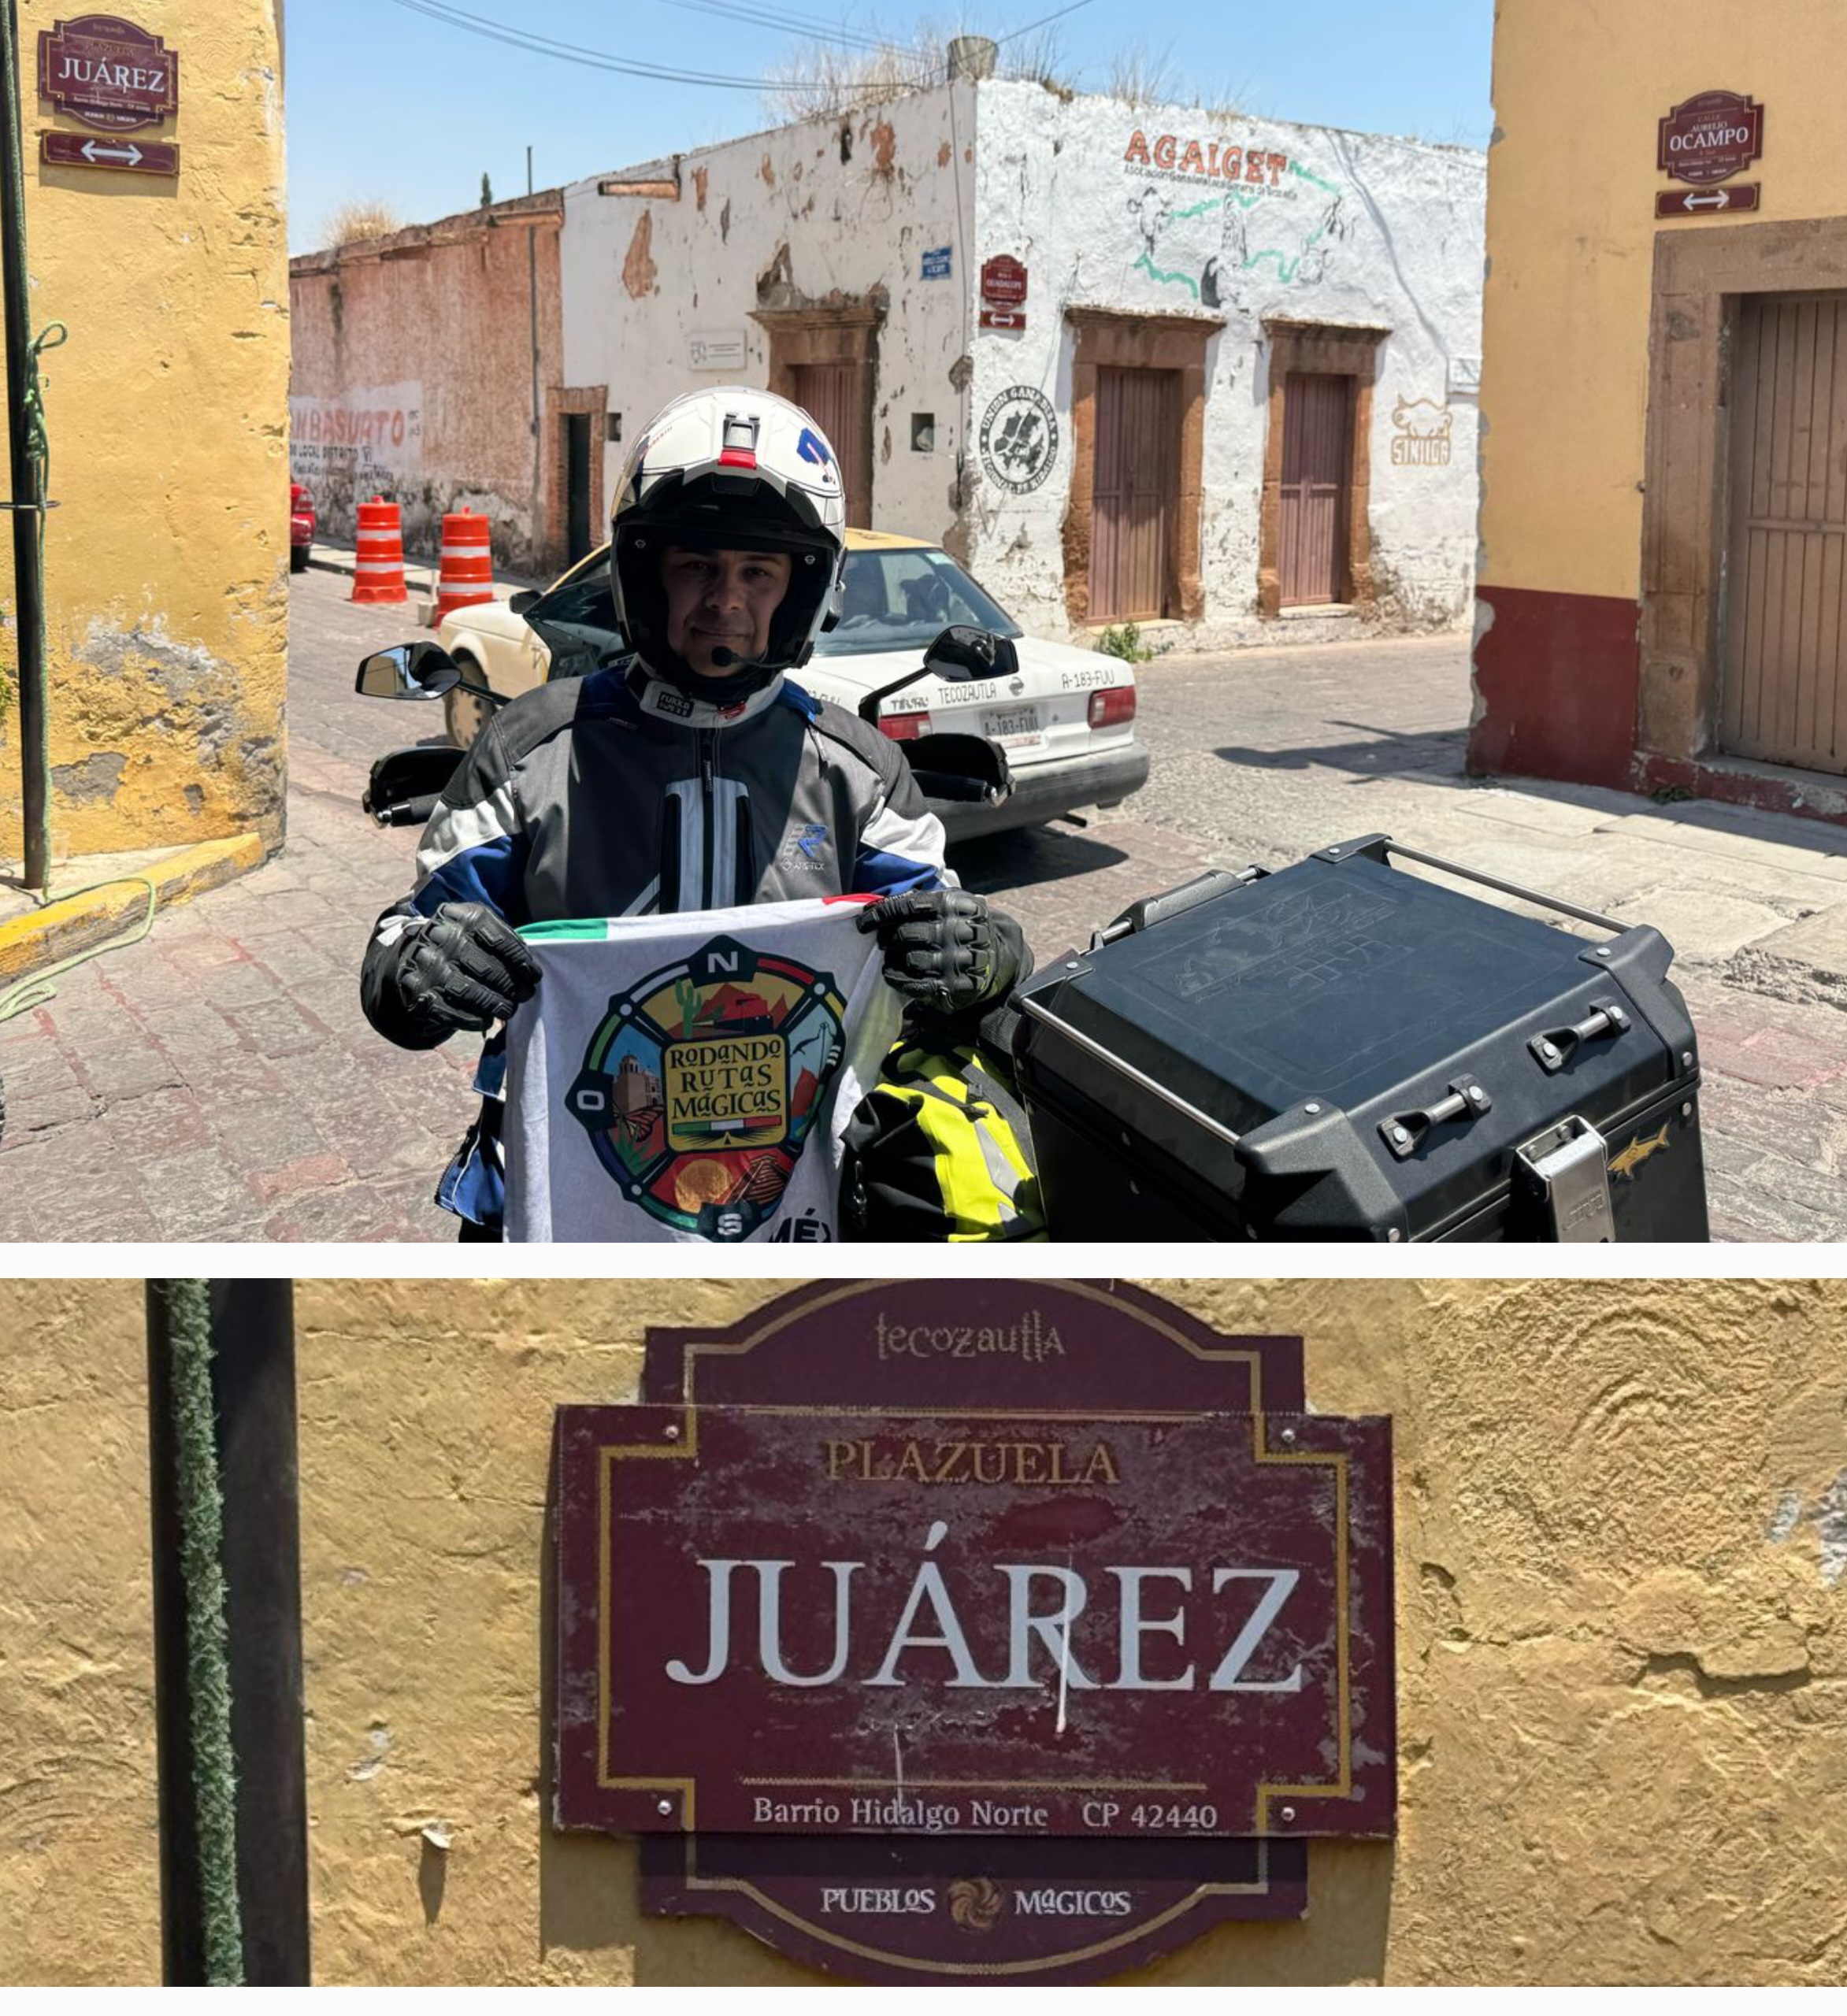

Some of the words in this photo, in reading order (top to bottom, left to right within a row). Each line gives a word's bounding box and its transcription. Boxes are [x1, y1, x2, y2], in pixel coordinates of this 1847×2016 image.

[58, 57, 165, 93] JUÁREZ
[1670, 127, 1749, 151] OCAMPO
[937, 682, 996, 705] TECOZAUTLA
[708, 951, 739, 973] N
[577, 1089, 604, 1110] O
[718, 1213, 742, 1236] S
[826, 1440, 1121, 1484] PLAZUELA
[666, 1521, 1304, 1692] JUÁREZ
[754, 1797, 840, 1824] Barrio
[851, 1797, 960, 1831] Hidalgo
[970, 1801, 1048, 1828] Norte
[1081, 1801, 1120, 1828] CP
[1130, 1804, 1218, 1829] 42440
[820, 1888, 936, 1914] PUEBLOS
